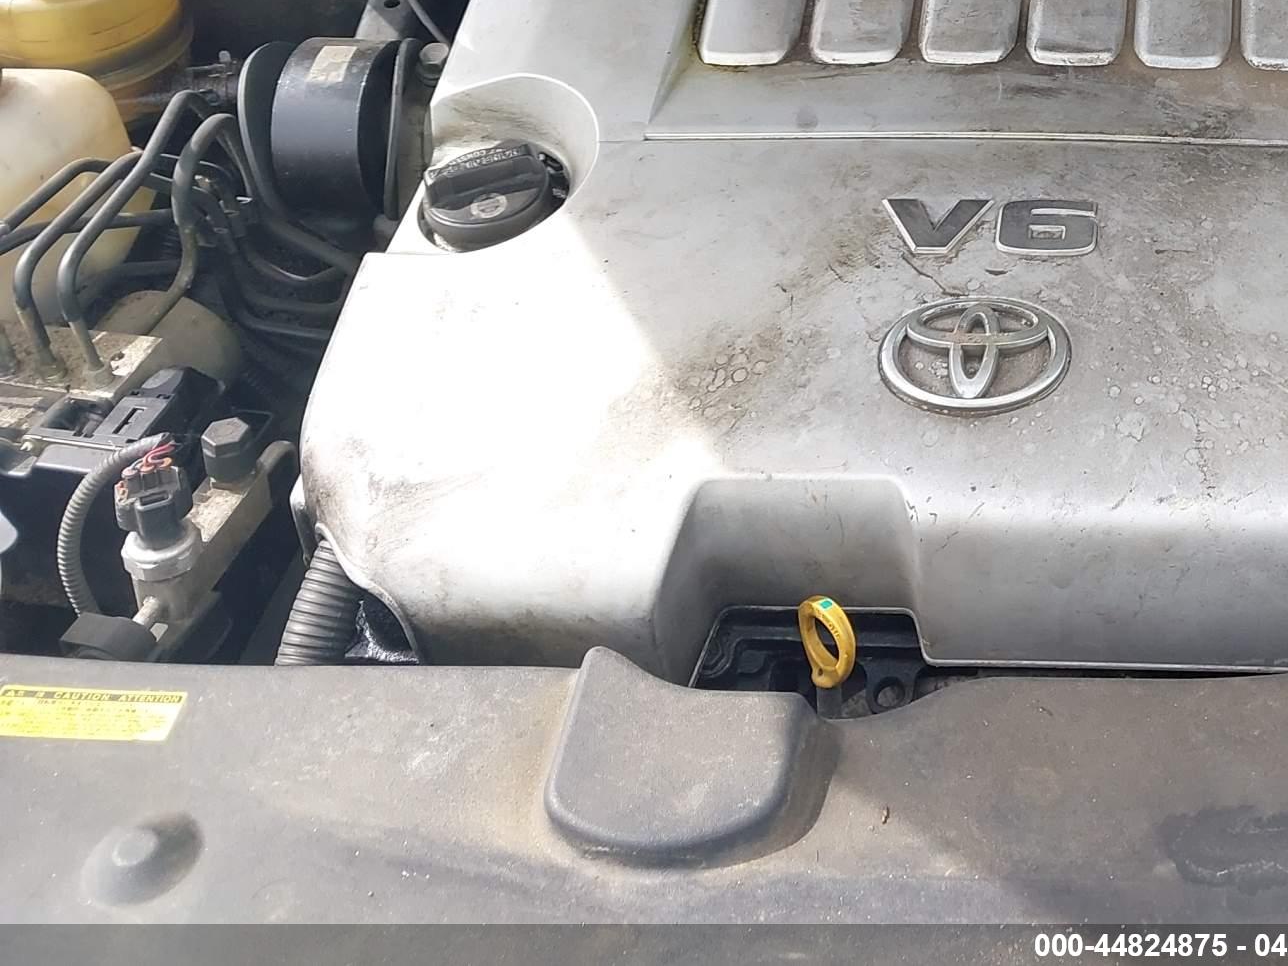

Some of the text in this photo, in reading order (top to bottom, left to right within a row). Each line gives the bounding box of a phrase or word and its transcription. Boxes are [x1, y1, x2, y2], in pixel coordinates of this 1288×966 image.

[881, 198, 1098, 257] V6
[54, 691, 112, 701] CAUTION
[118, 694, 181, 704] ATTENTION
